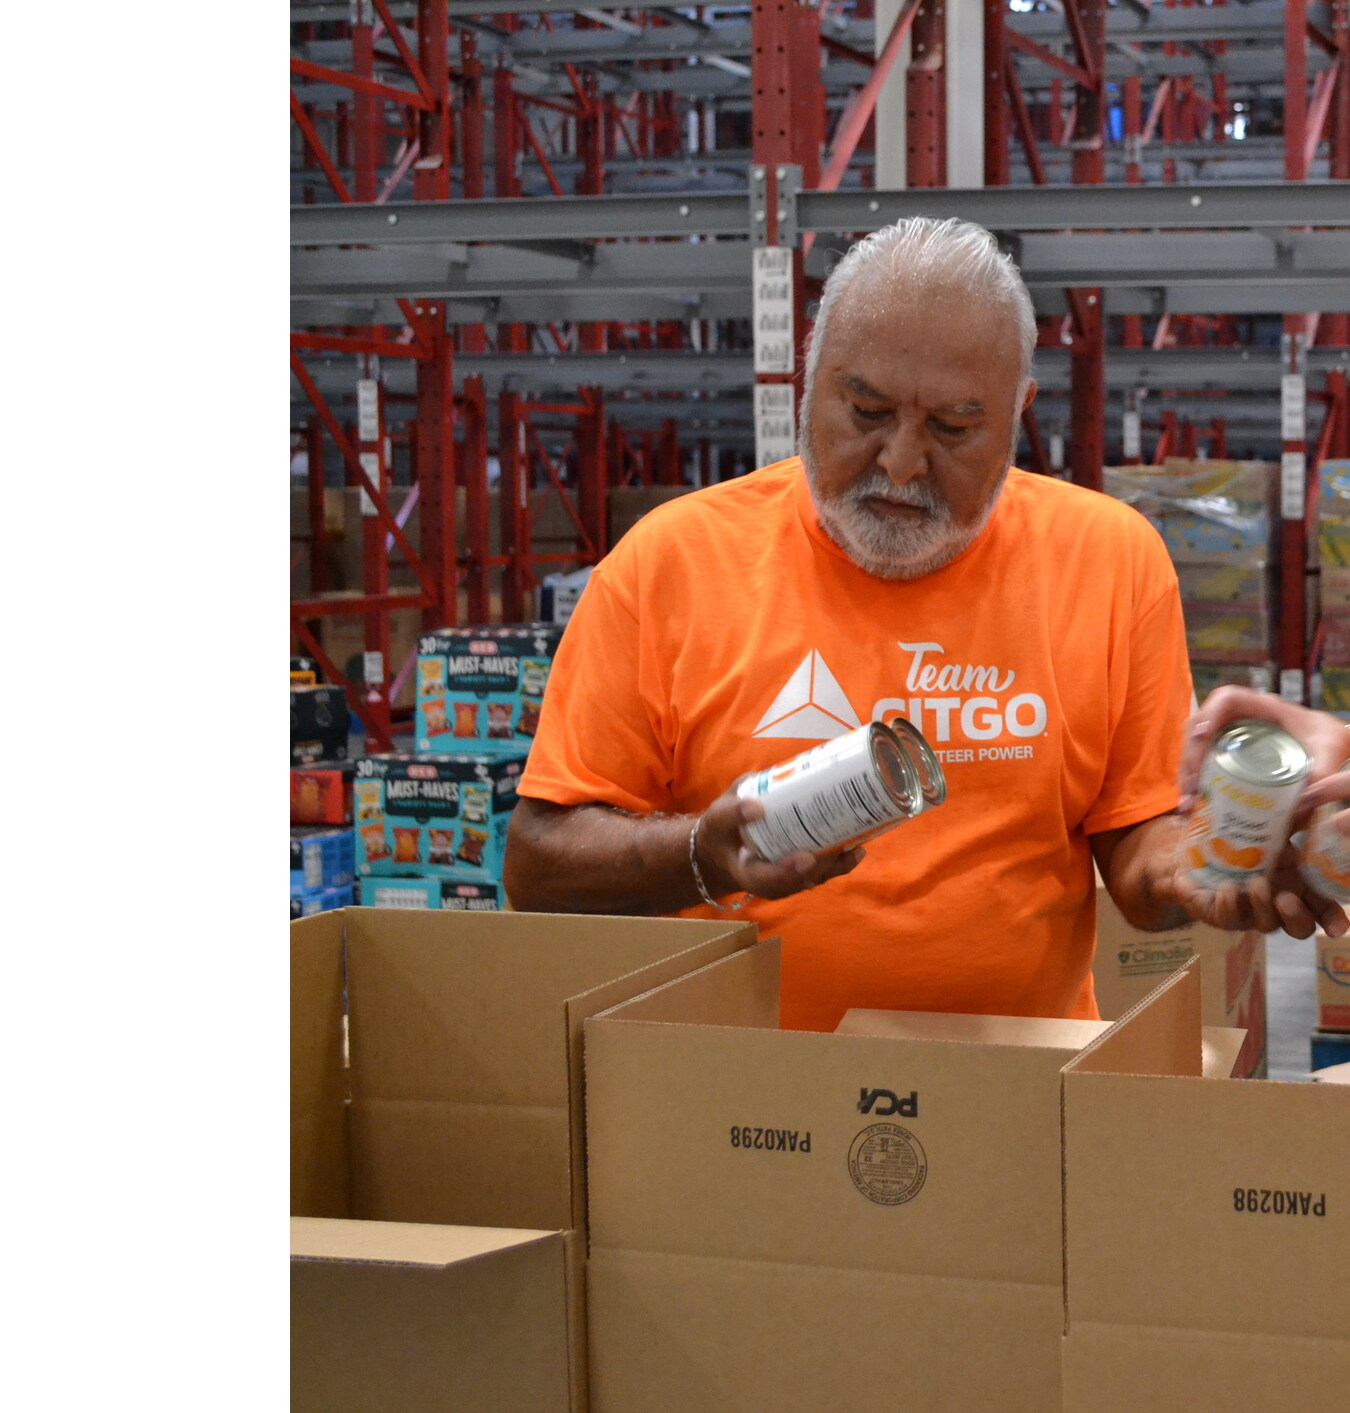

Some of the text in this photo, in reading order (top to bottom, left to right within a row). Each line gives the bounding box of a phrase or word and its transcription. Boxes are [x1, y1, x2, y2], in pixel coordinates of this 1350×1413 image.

[420, 637, 436, 654] 30
[449, 656, 519, 676] MUST-HAVES
[897, 640, 1015, 692] Team
[979, 745, 1034, 761] POWER
[356, 760, 373, 777] 30
[386, 779, 459, 801] MUST-HAVES
[857, 1087, 918, 1118] PCA
[730, 1126, 812, 1153] PAK0298
[1233, 1188, 1326, 1217] PAK0298
